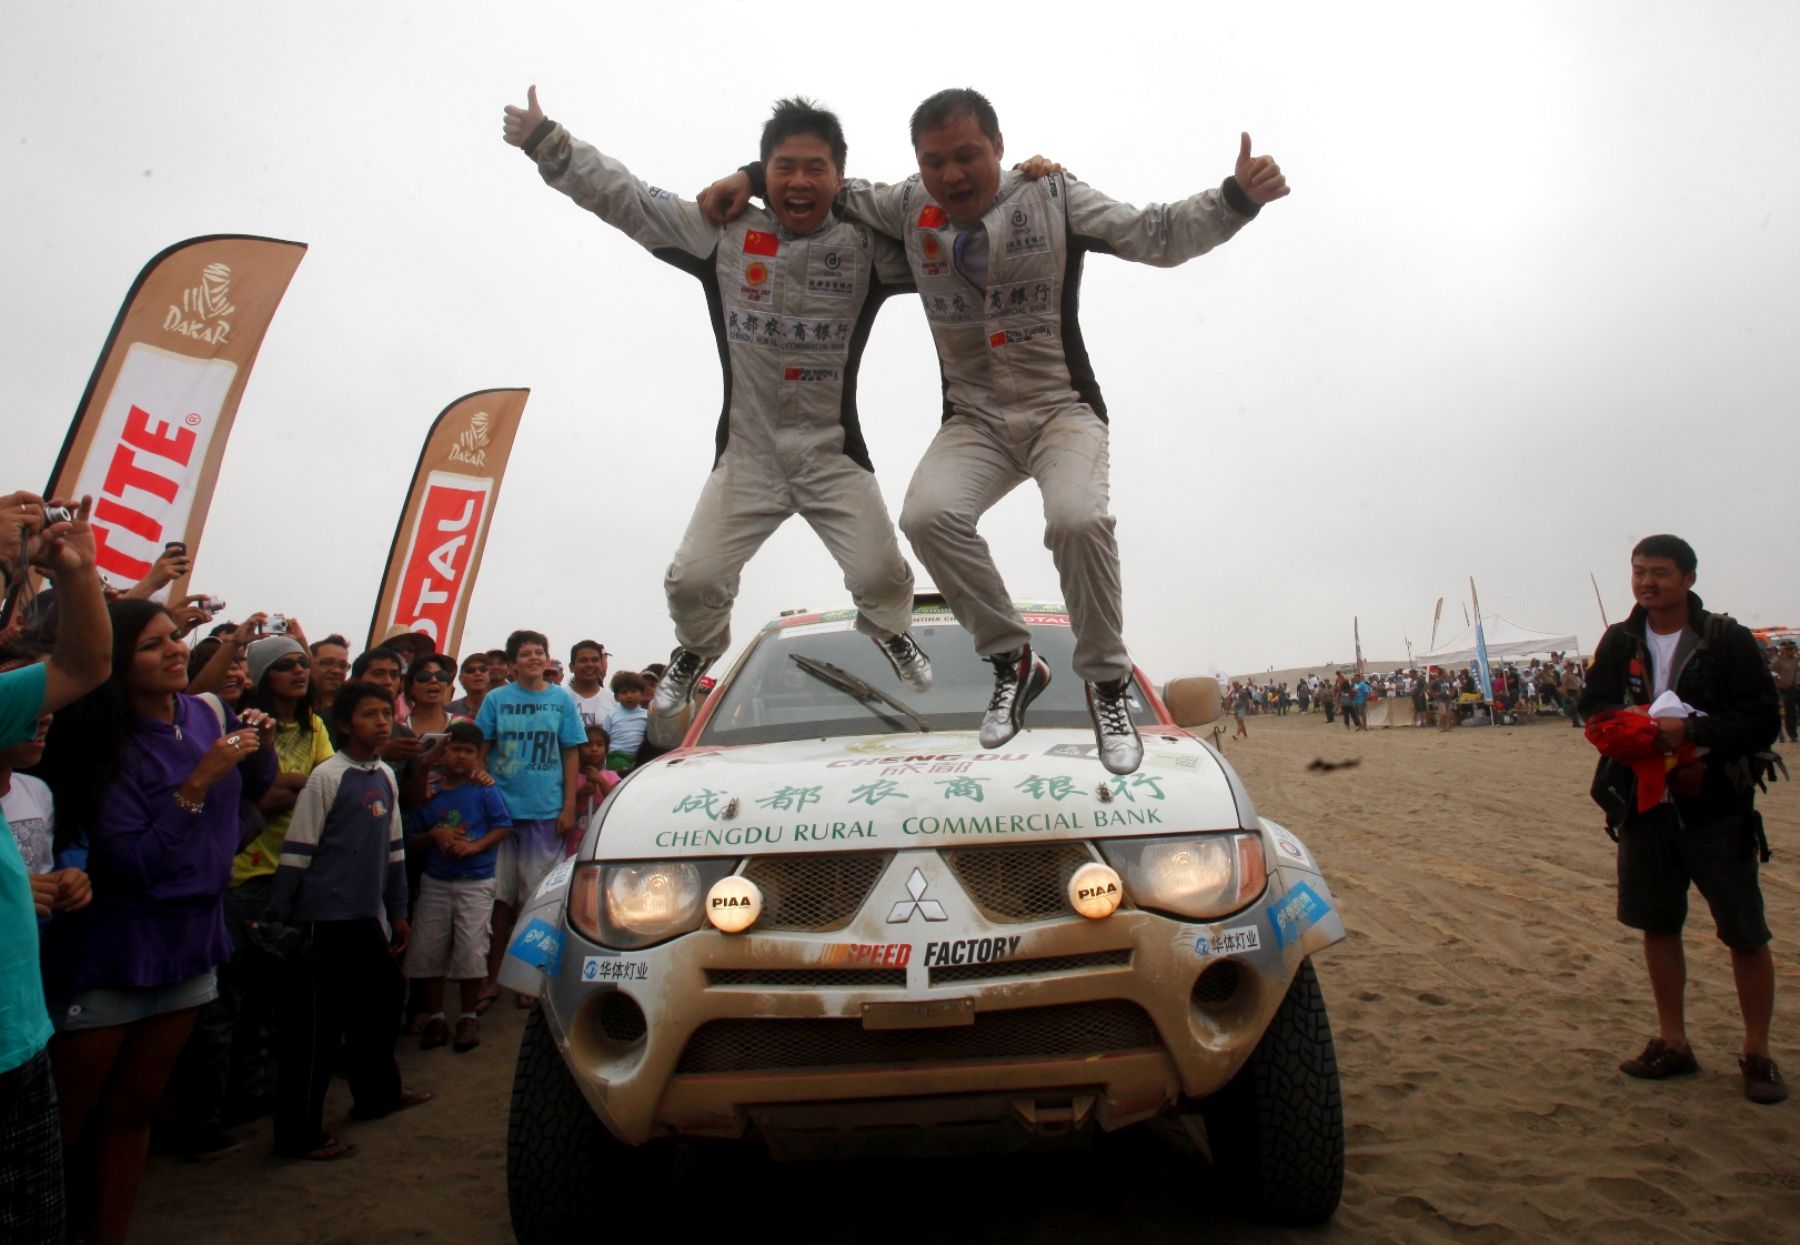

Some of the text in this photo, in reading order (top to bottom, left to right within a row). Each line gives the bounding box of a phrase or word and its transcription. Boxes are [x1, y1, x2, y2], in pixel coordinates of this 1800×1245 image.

[162, 304, 232, 345] DAKAR
[447, 444, 487, 467] DAKAR
[826, 753, 1030, 768] CHENG DU
[655, 807, 1163, 848] CHENGDU RURAL COMMERCIAL BANK
[712, 895, 752, 908] PIAA
[1077, 882, 1118, 900] PIAA
[849, 935, 1021, 969] SPEED FACTORY
[600, 960, 649, 981] 华体灯业
